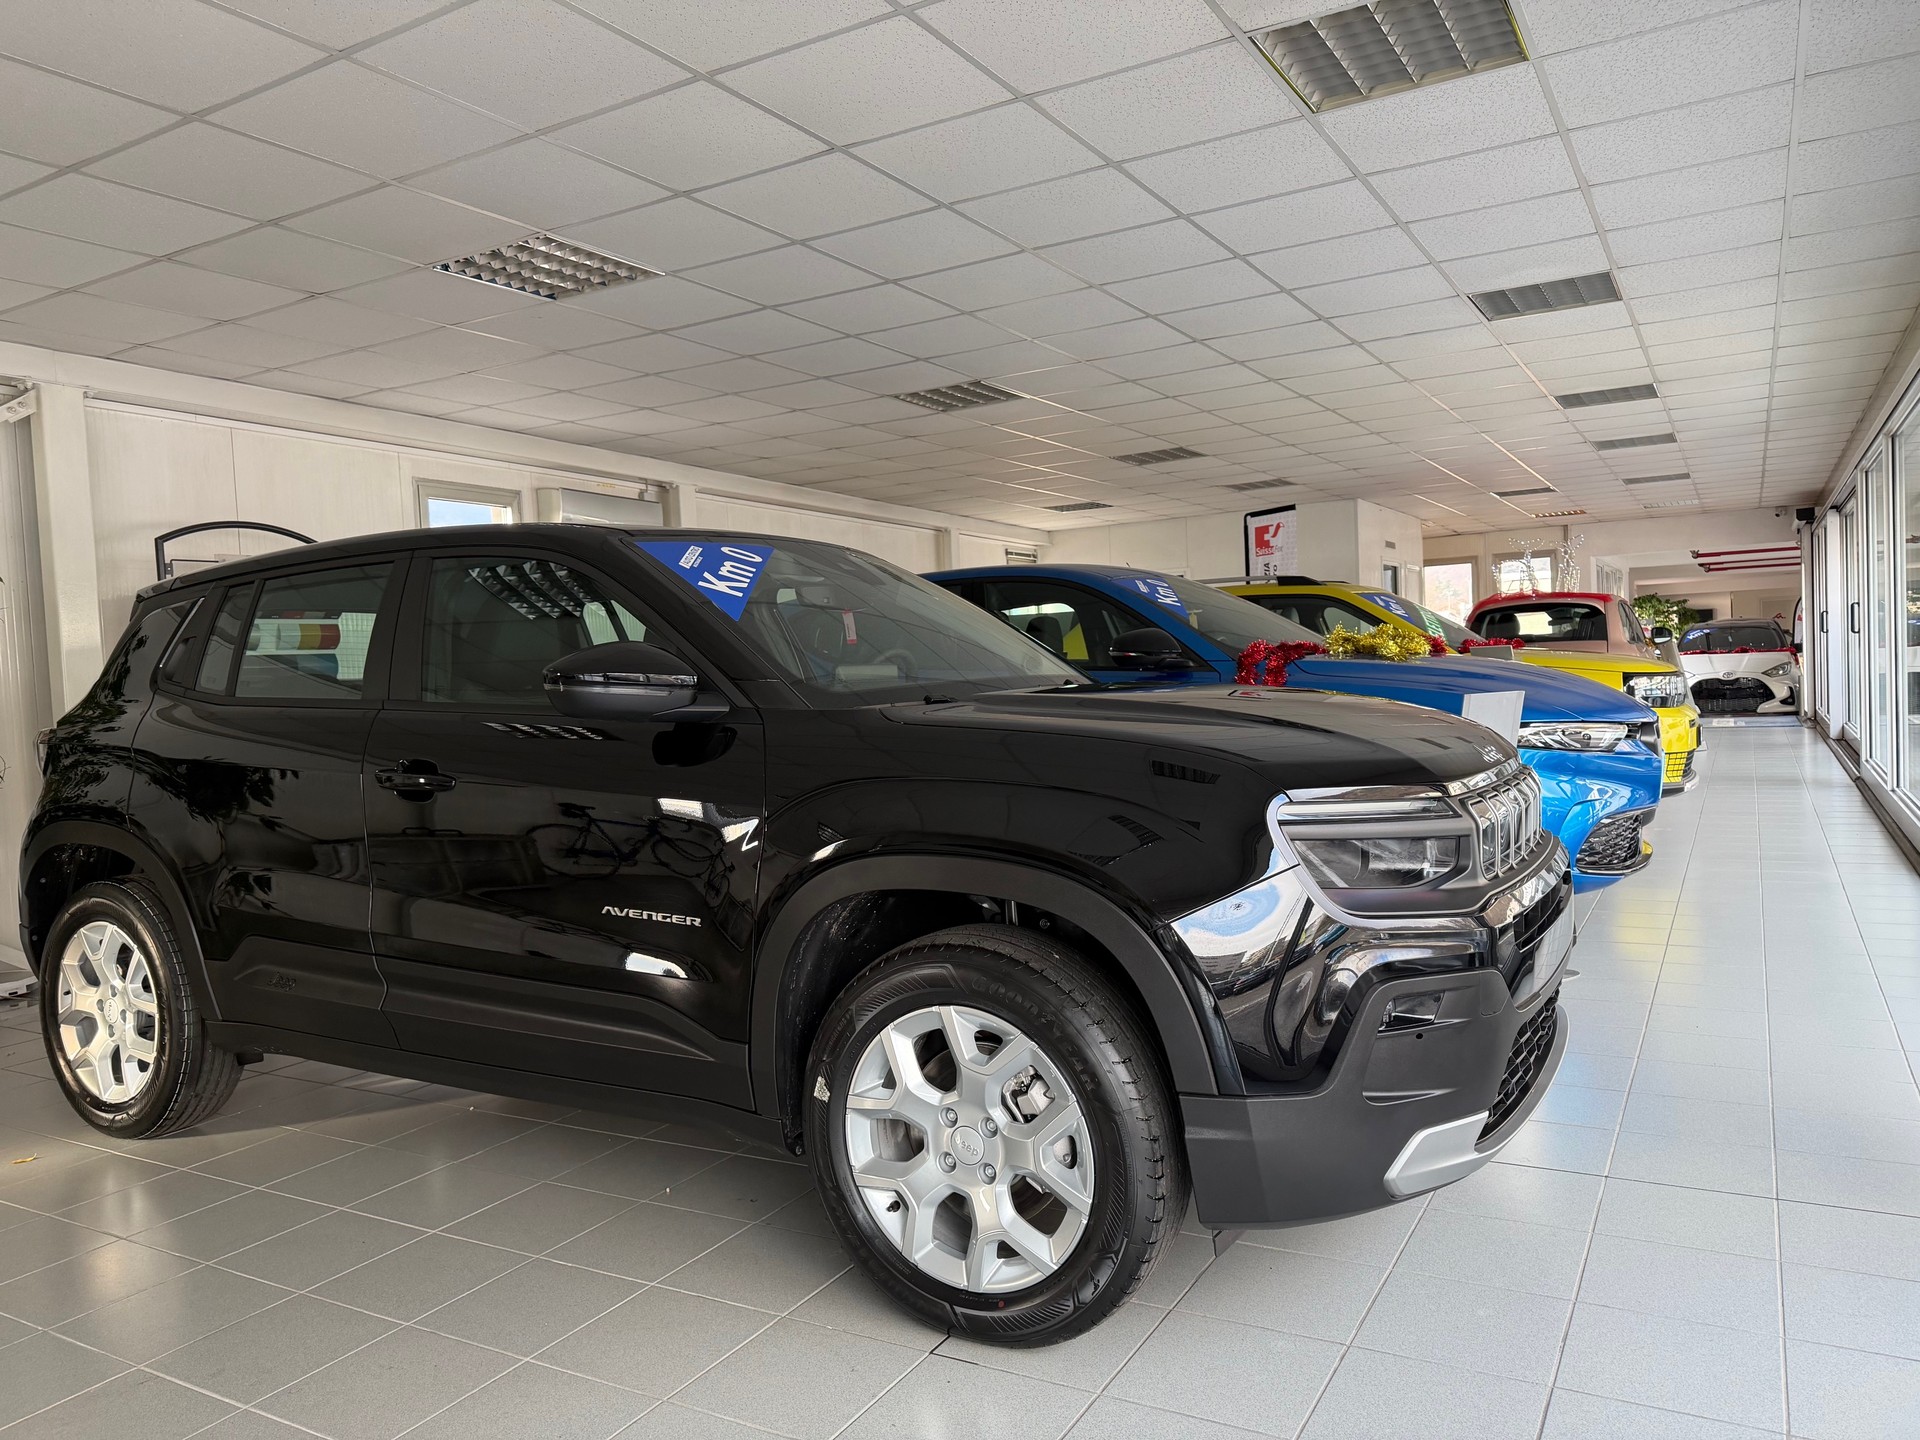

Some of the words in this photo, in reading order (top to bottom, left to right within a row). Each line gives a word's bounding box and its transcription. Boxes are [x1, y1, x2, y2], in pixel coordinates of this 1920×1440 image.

[720, 546, 763, 563] 0
[697, 560, 757, 598] Km
[1154, 585, 1181, 607] Km
[601, 905, 702, 927] AVENGER
[954, 1131, 979, 1157] Jeep
